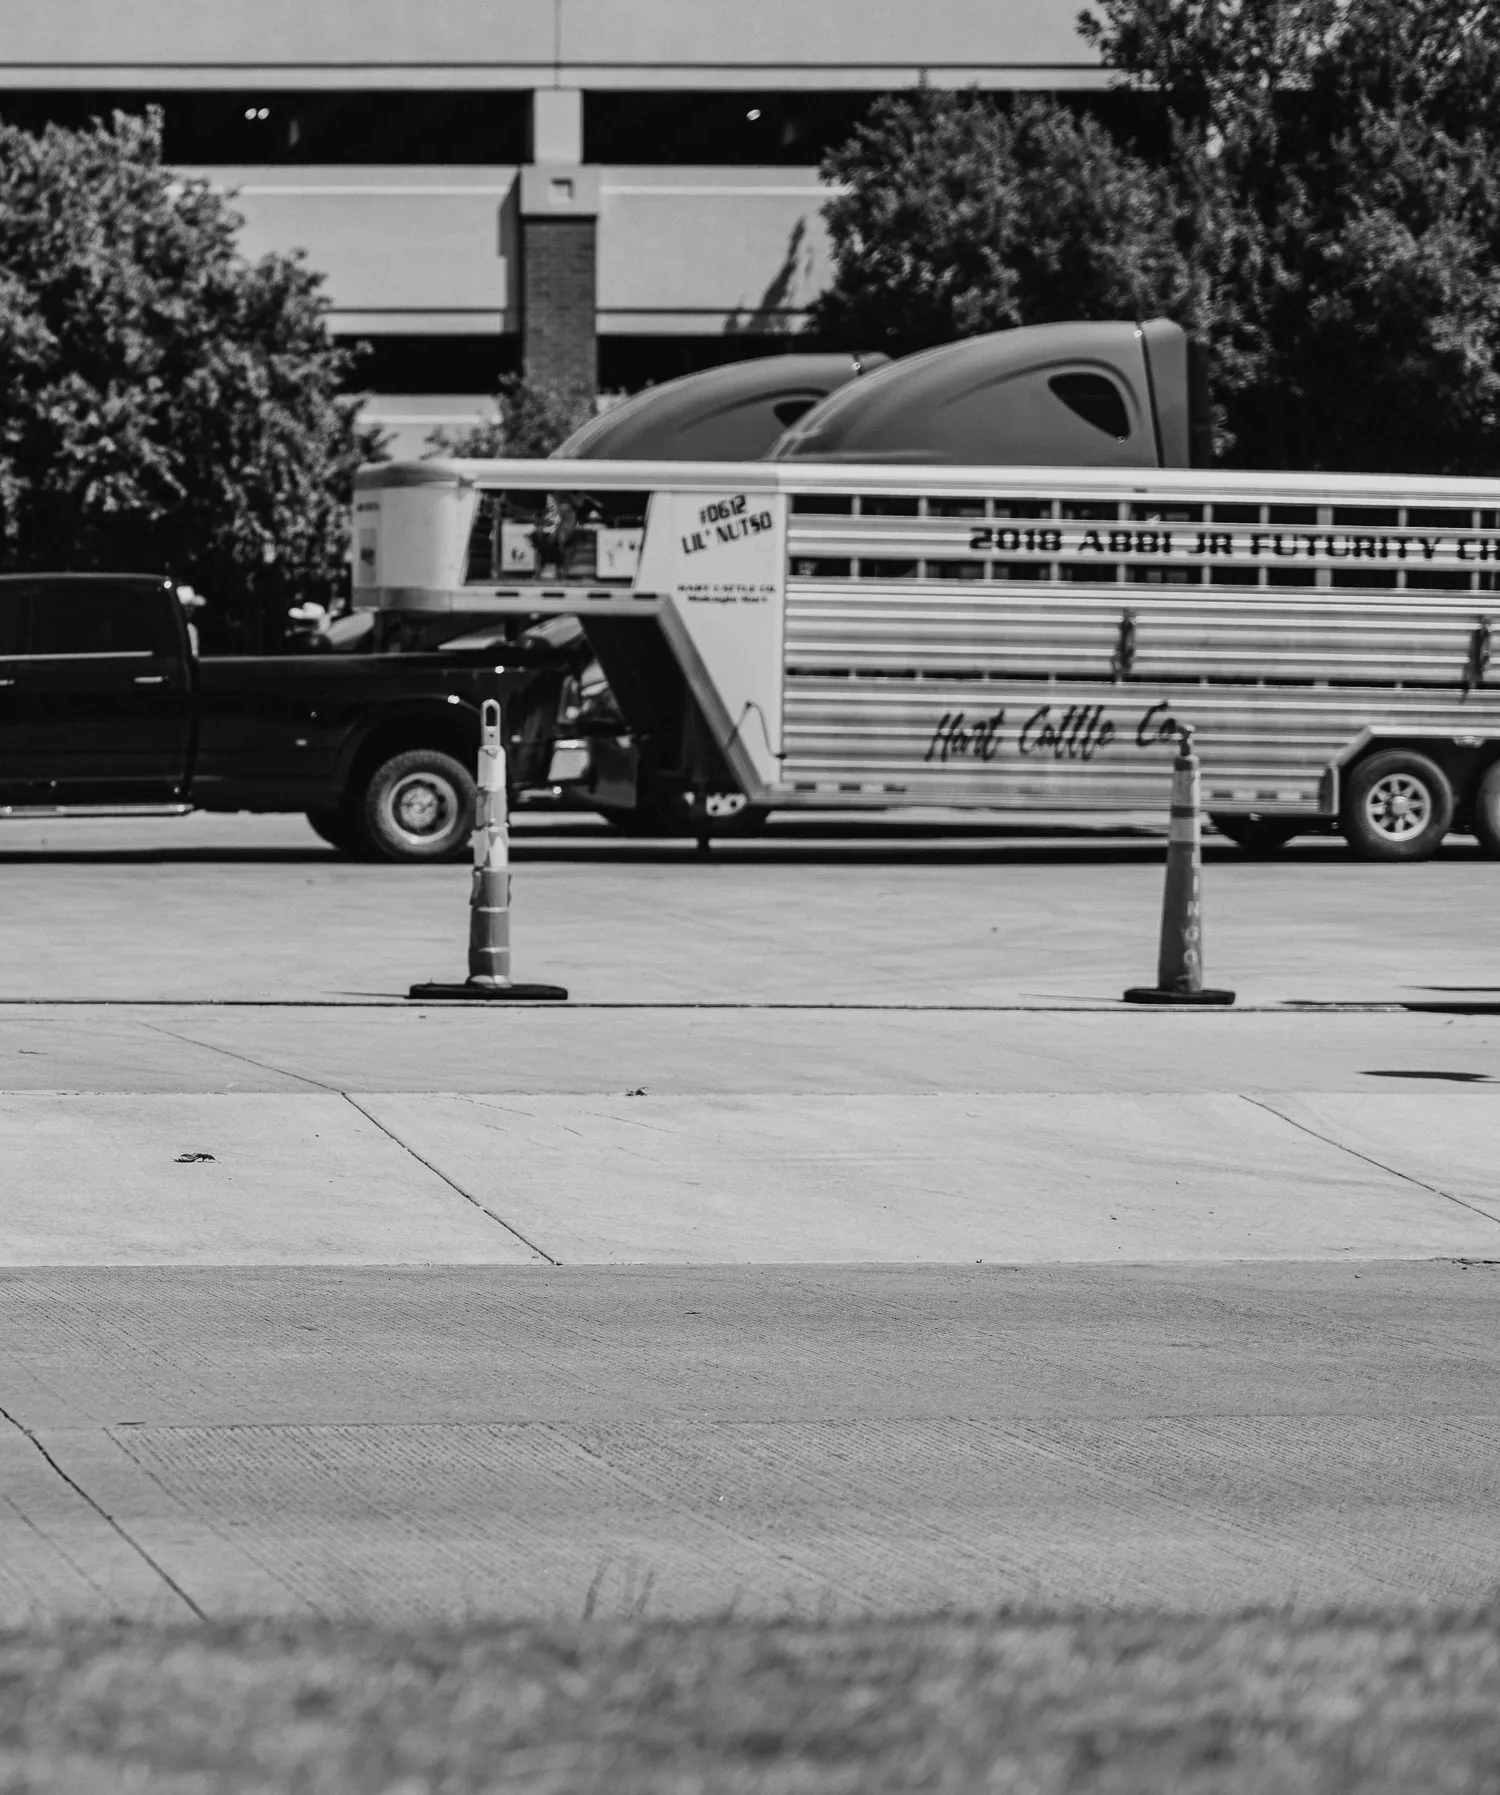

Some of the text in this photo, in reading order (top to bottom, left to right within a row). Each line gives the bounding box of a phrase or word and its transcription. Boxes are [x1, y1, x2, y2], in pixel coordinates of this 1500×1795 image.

[700, 494, 747, 524] #0612
[681, 510, 772, 554] LIL' NUTSO
[968, 526, 1062, 551] 2018
[1078, 528, 1173, 553] ABBI
[1187, 530, 1233, 555] JR
[1250, 534, 1442, 559] FUTURITY
